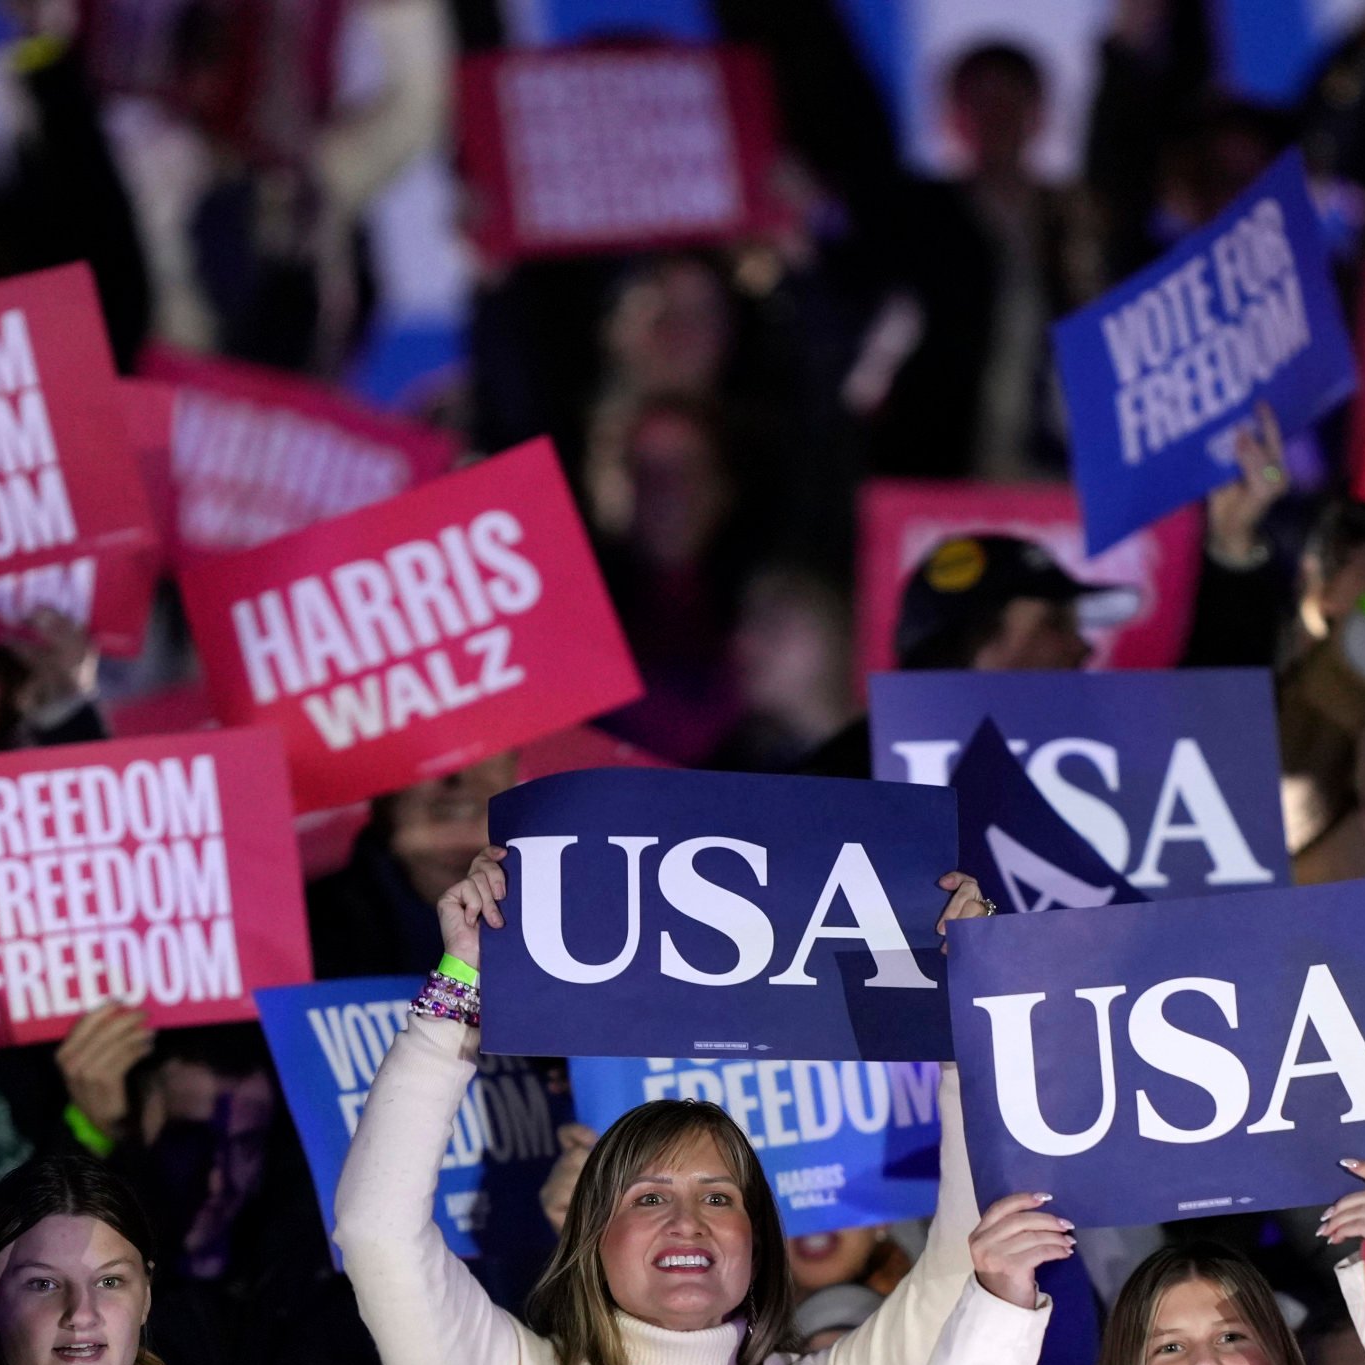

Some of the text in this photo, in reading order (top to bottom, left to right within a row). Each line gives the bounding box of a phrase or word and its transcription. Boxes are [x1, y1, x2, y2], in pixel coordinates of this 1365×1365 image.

[1102, 197, 1291, 385] VOTE FOR
[1116, 275, 1311, 464] FREEDOM
[232, 510, 543, 706] HARRIS
[304, 625, 525, 751] WALZ
[508, 836, 938, 988] USA
